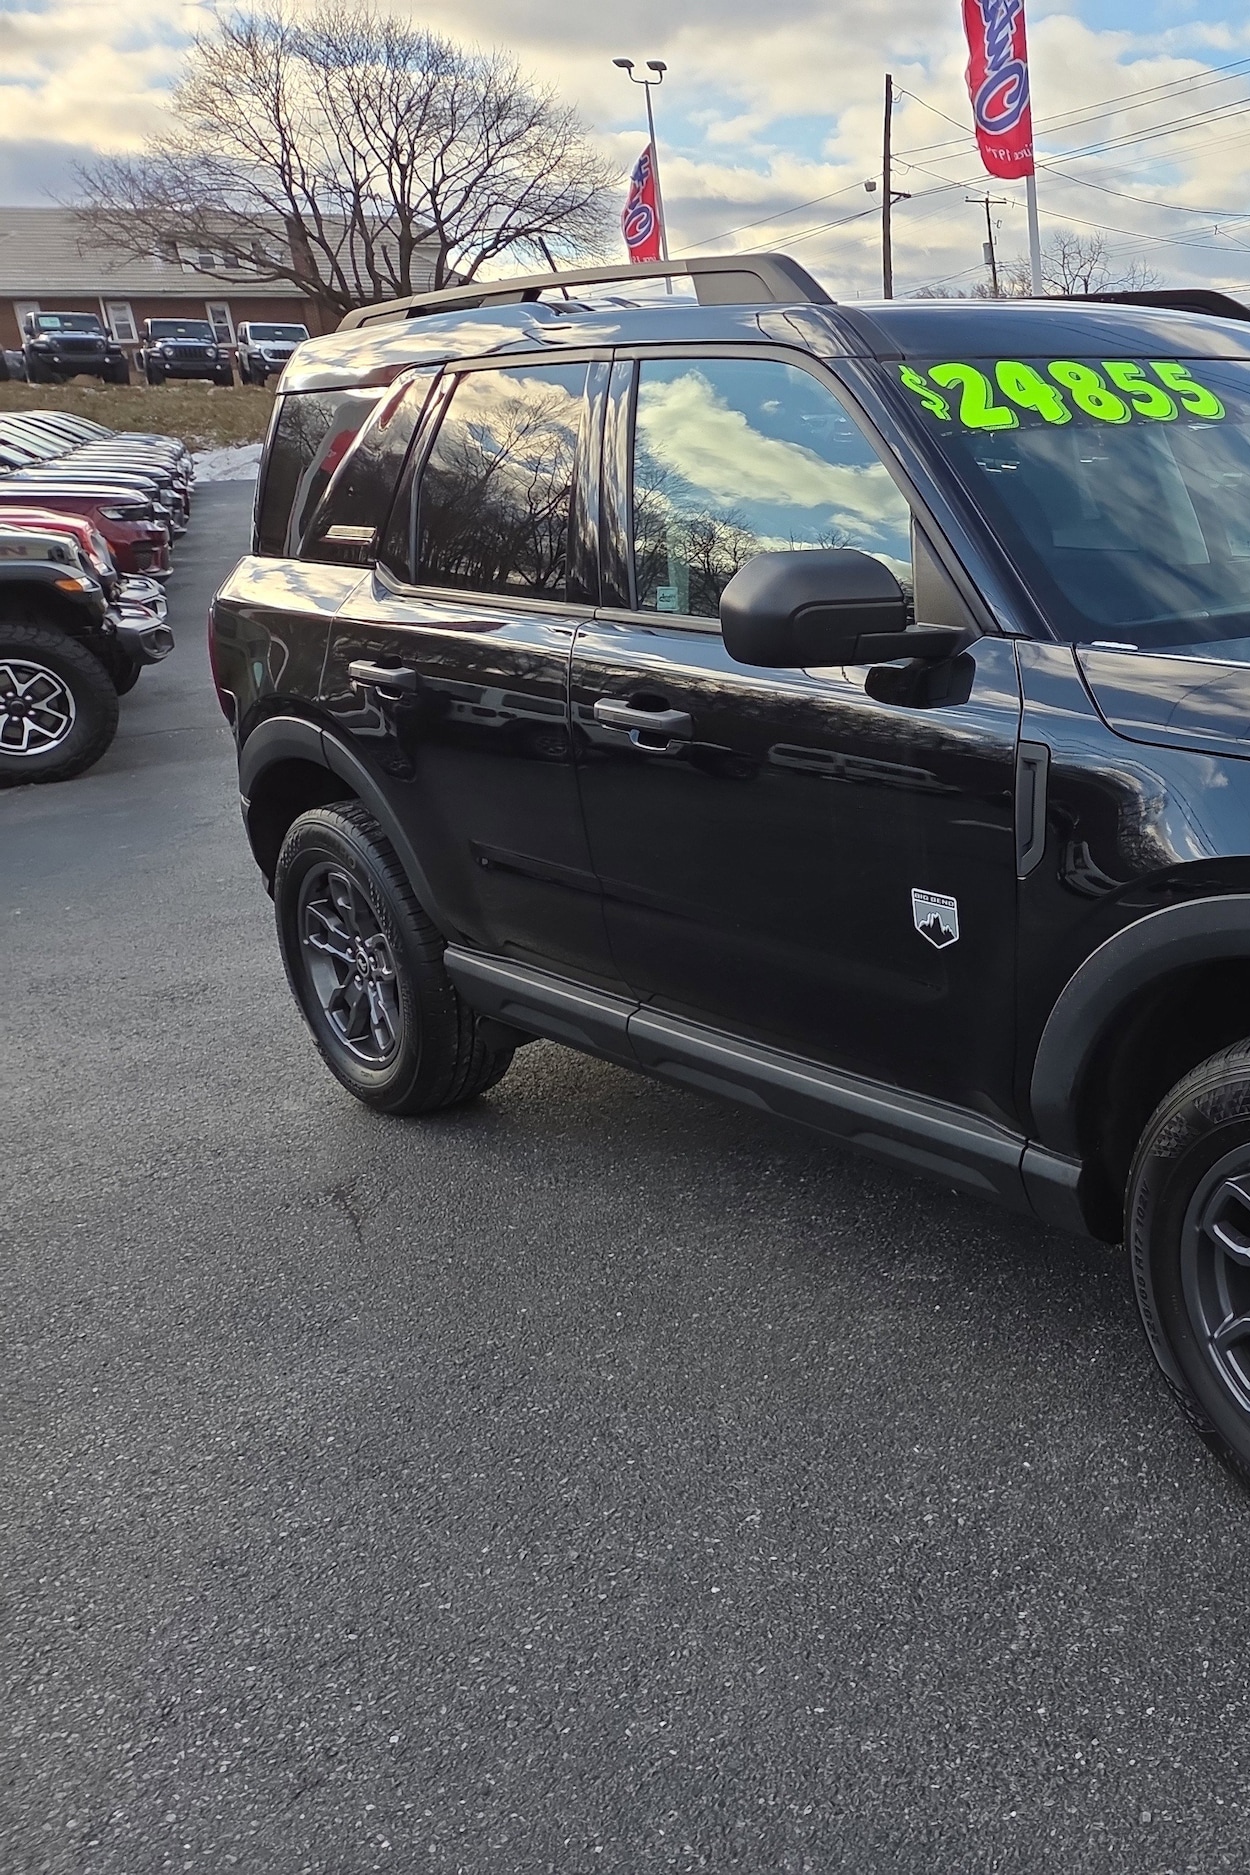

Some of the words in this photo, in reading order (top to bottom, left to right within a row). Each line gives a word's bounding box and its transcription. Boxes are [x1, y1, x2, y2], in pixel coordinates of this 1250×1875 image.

[898, 361, 1226, 430] $24855
[914, 893, 929, 901] BIG
[930, 897, 954, 907] BEND
